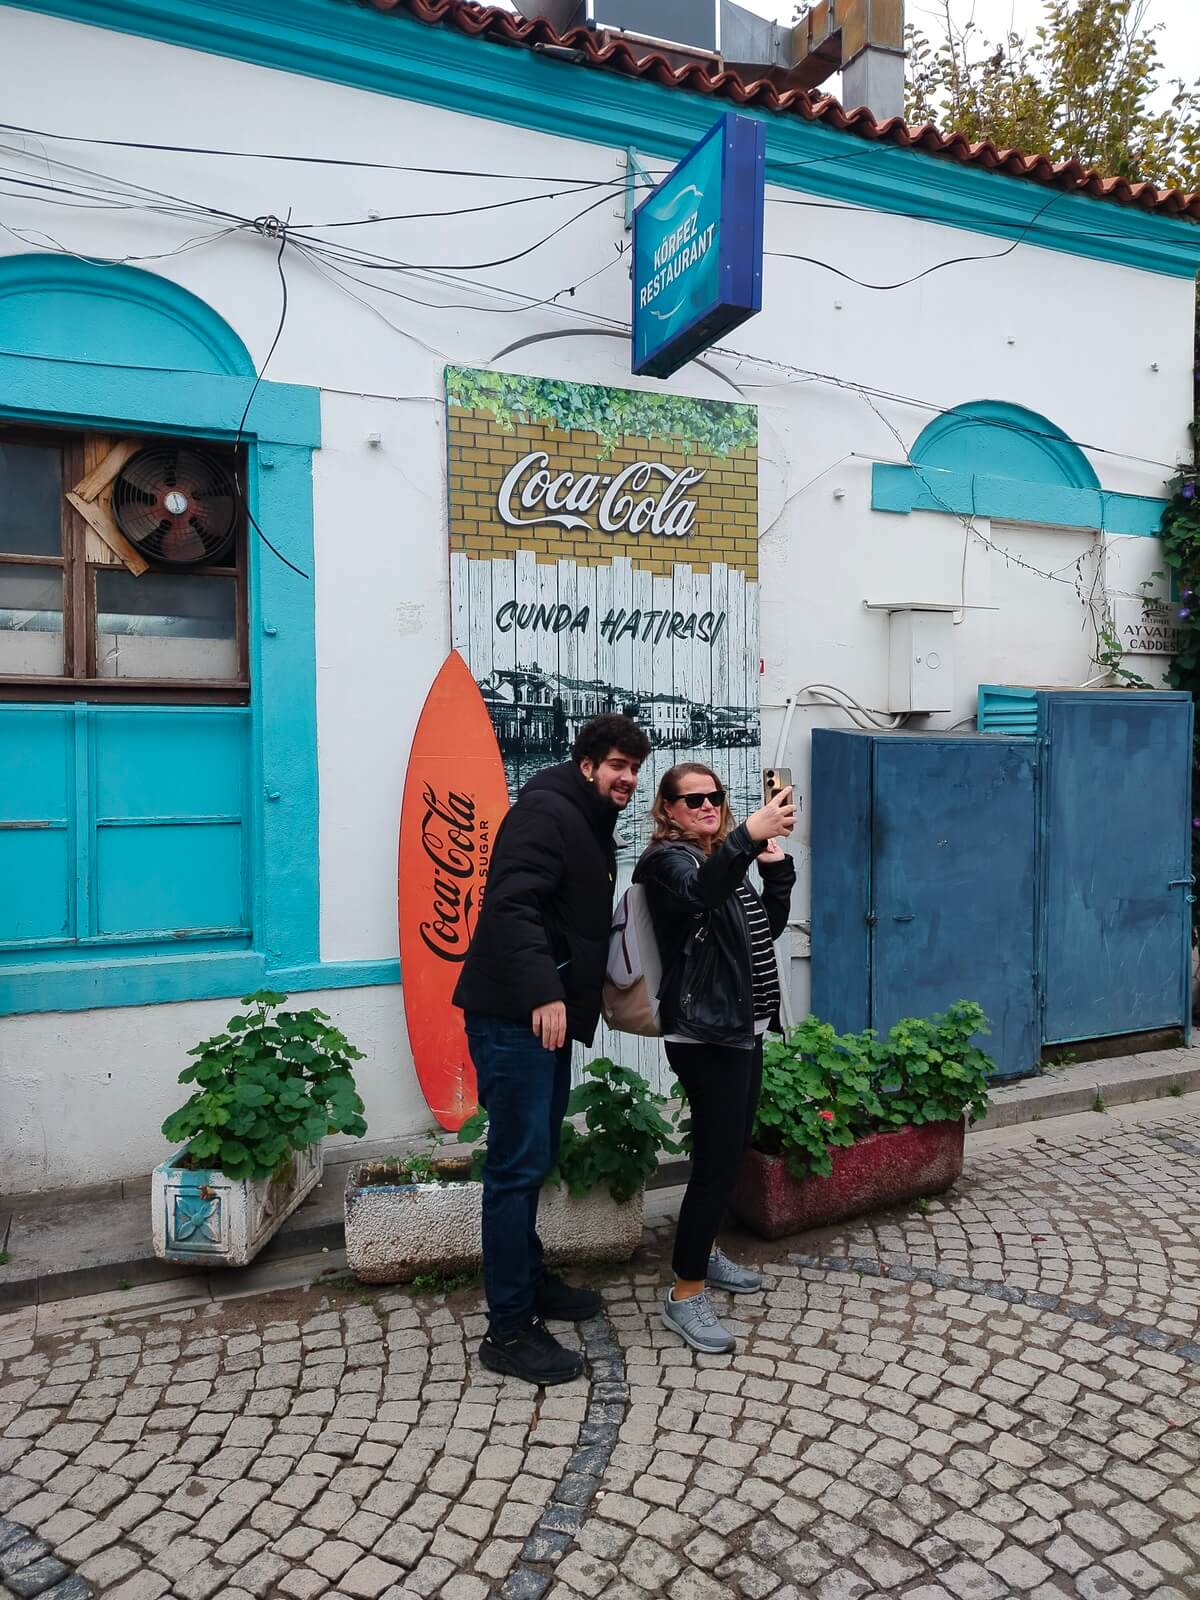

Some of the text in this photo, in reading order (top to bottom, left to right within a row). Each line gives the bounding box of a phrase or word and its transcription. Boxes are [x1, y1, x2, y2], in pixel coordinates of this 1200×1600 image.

[640, 222, 715, 310] RESTAURANT
[654, 210, 699, 271] KÖRFEZ
[498, 451, 707, 536] Coca-Cola
[495, 600, 727, 646] CUNDA HATIRASI
[419, 780, 476, 963] Coca-Cola
[479, 820, 489, 878] SUGAR
